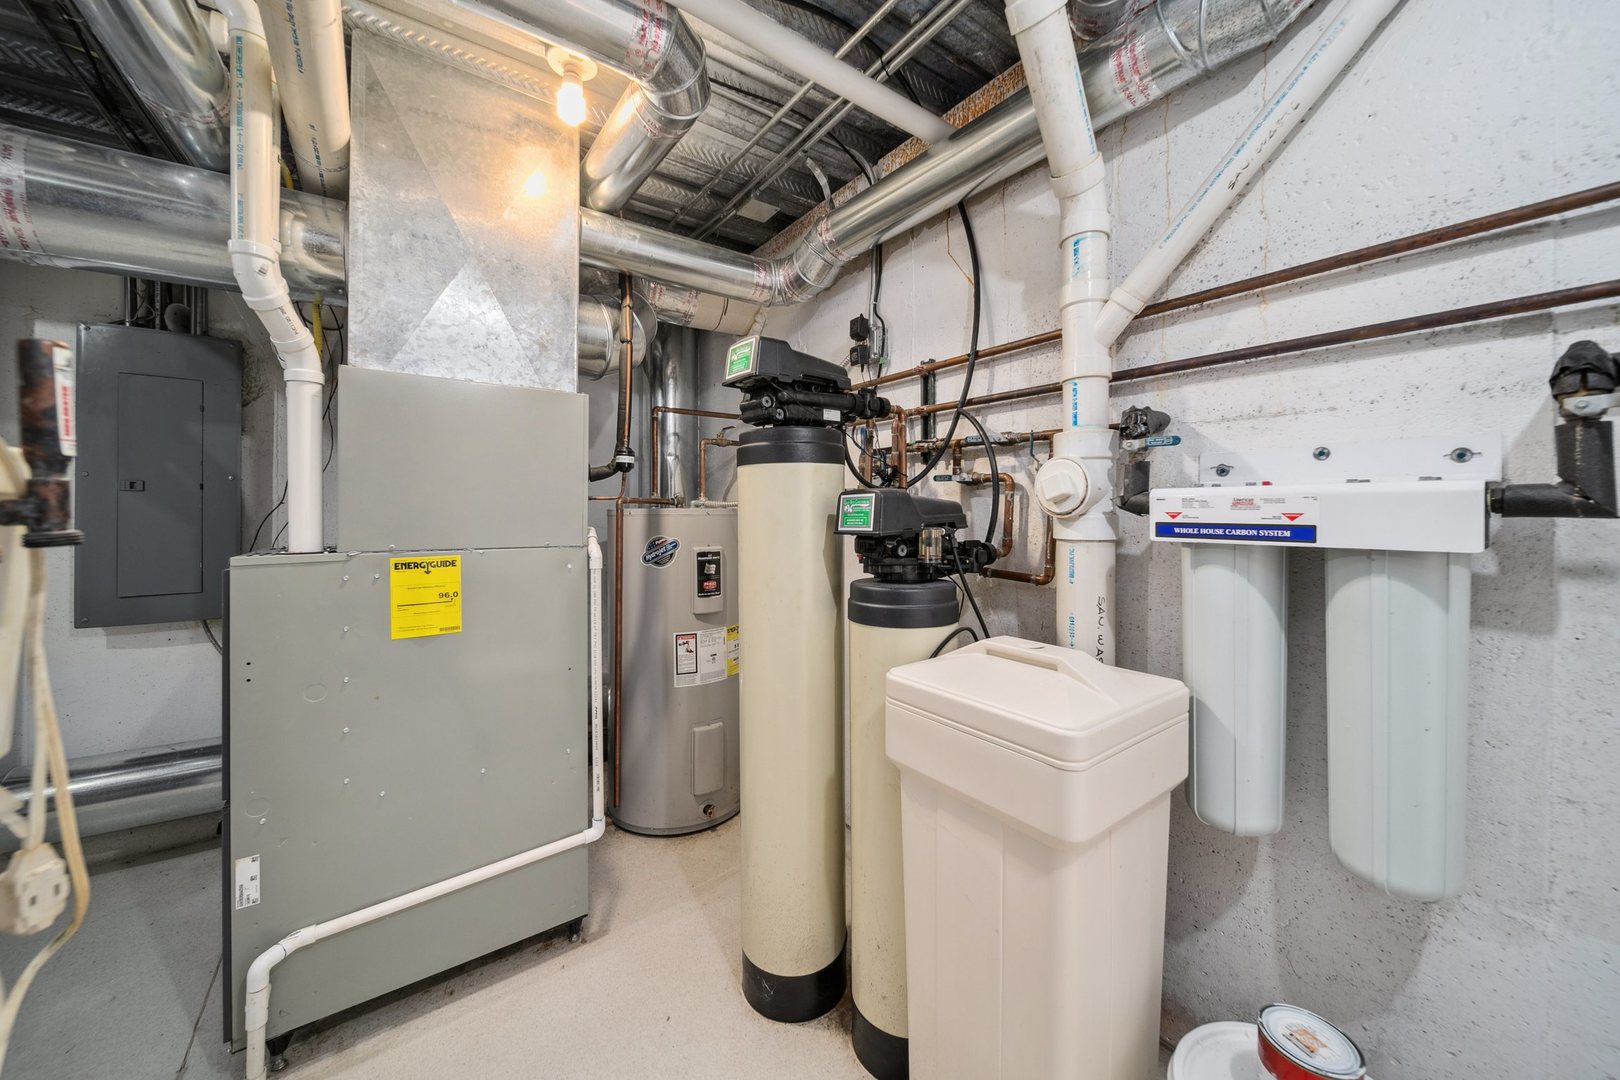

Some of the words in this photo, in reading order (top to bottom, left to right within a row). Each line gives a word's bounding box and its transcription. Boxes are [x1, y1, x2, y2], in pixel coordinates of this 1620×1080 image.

[1174, 527, 1200, 535] WHOLE
[1225, 528, 1258, 536] CARBON
[1258, 529, 1291, 537] SYSTEM
[394, 559, 457, 572] ENERGYGUIDE
[438, 591, 459, 599] 96.0
